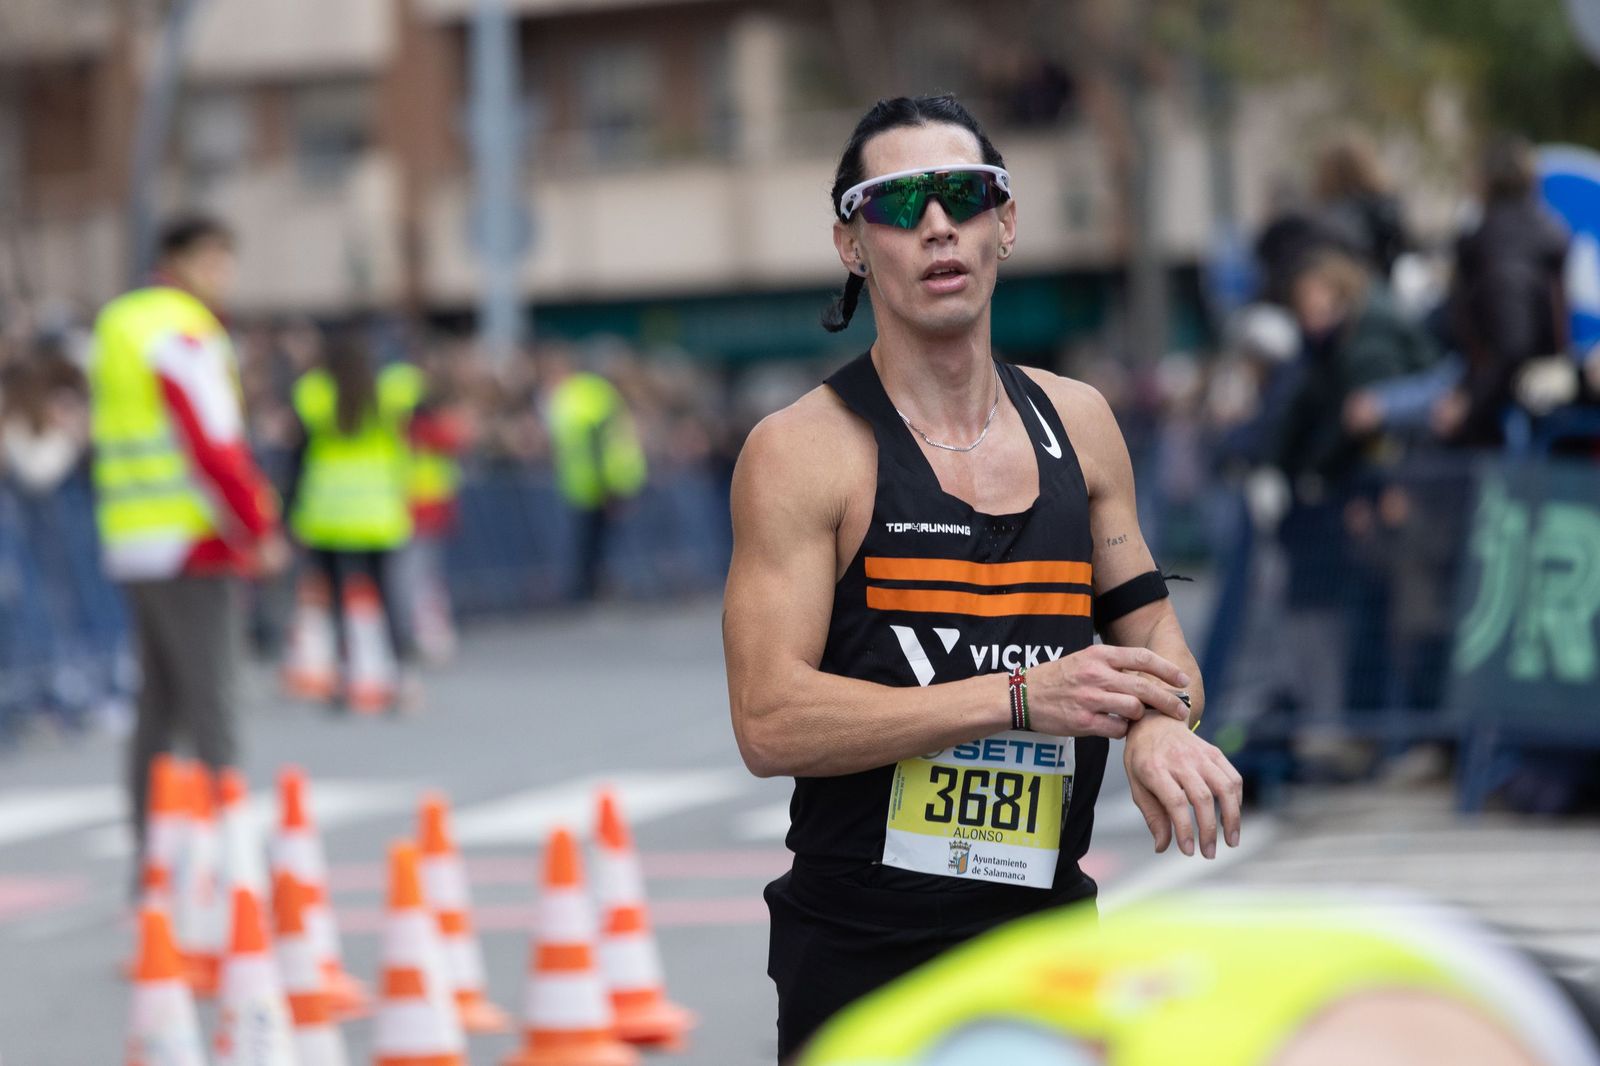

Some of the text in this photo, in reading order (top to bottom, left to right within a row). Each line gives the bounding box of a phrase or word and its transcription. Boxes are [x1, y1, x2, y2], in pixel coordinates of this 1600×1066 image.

[1106, 534, 1128, 547] fast
[970, 644, 1064, 671] VICKY
[924, 765, 1042, 834] 3681
[953, 826, 1004, 843] ALONSO
[972, 853, 1028, 869] Ayuntamiento
[971, 866, 1026, 881] de Salamanca
